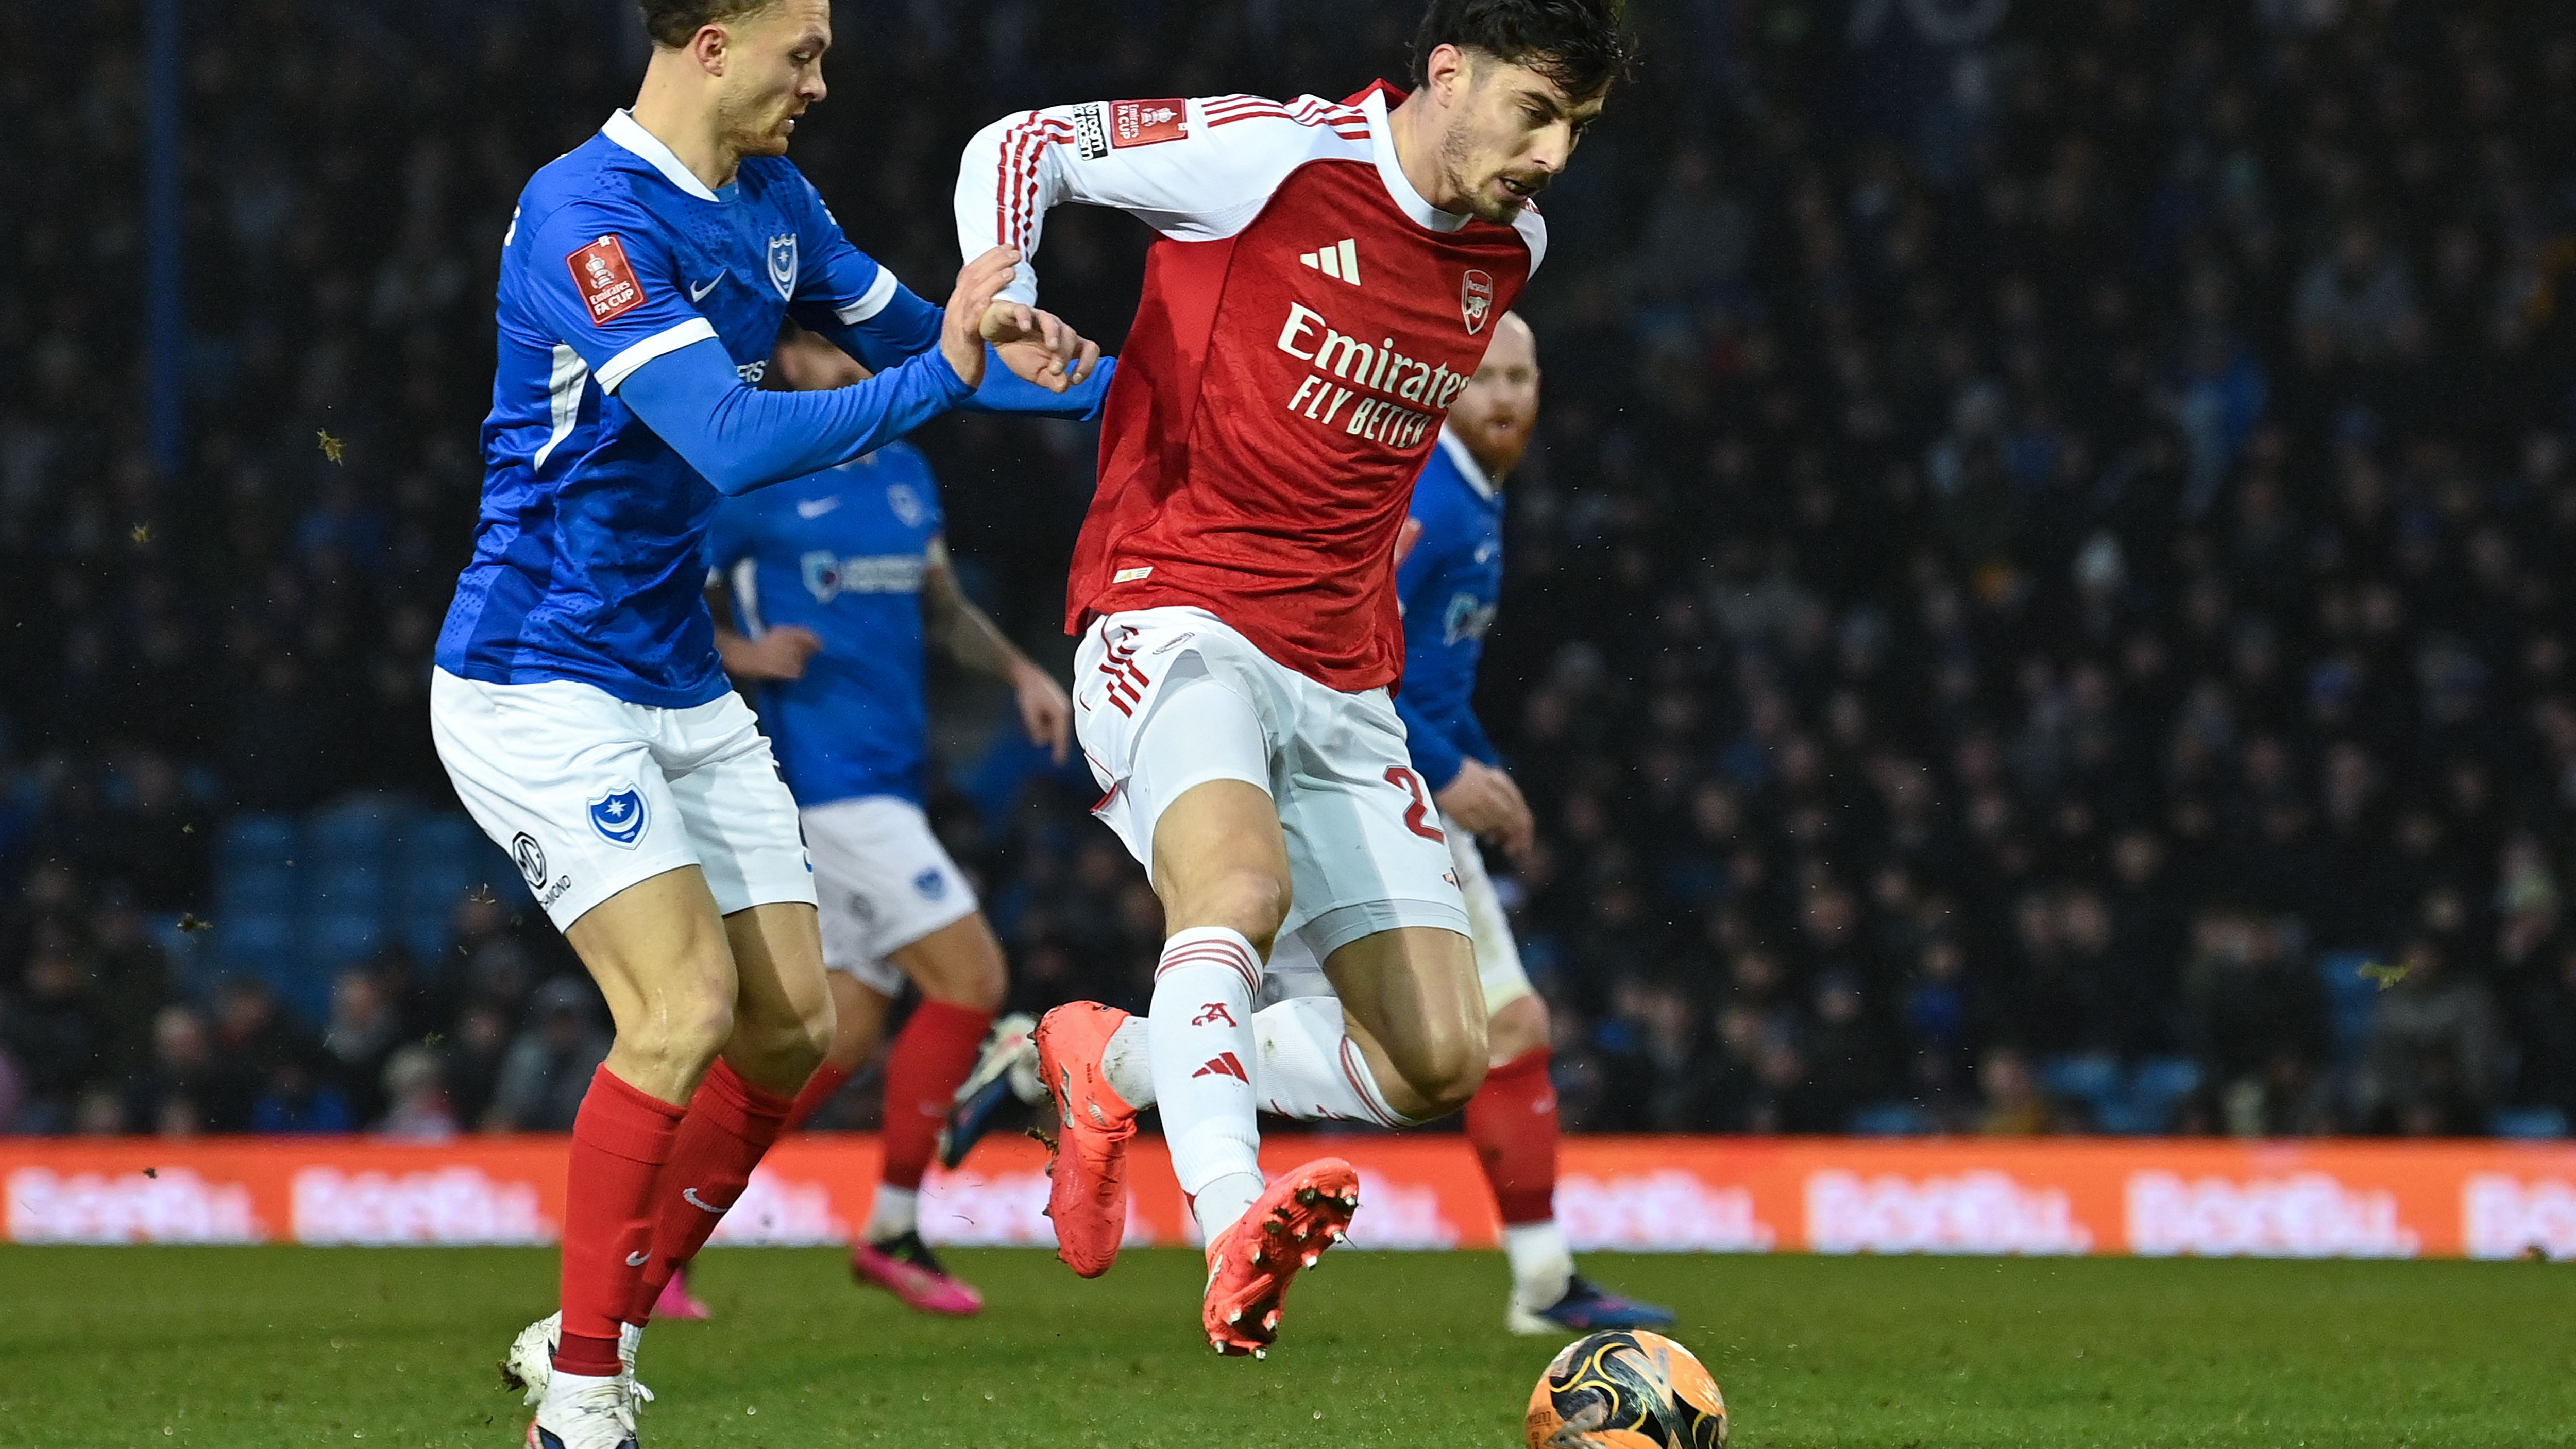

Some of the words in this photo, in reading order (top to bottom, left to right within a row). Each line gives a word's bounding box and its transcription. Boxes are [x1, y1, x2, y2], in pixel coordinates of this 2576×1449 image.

[1117, 105, 1129, 116] FA
[1118, 116, 1131, 139] CUP
[1129, 104, 1140, 138] Emirates
[1075, 116, 1093, 161] racism
[1086, 115, 1105, 152] room
[589, 280, 630, 305] Emirates
[594, 302, 611, 316] FA
[608, 288, 634, 307] CUP
[1287, 375, 1355, 424] FLY
[1346, 398, 1431, 448] BETTER
[1383, 765, 1445, 845] 2
